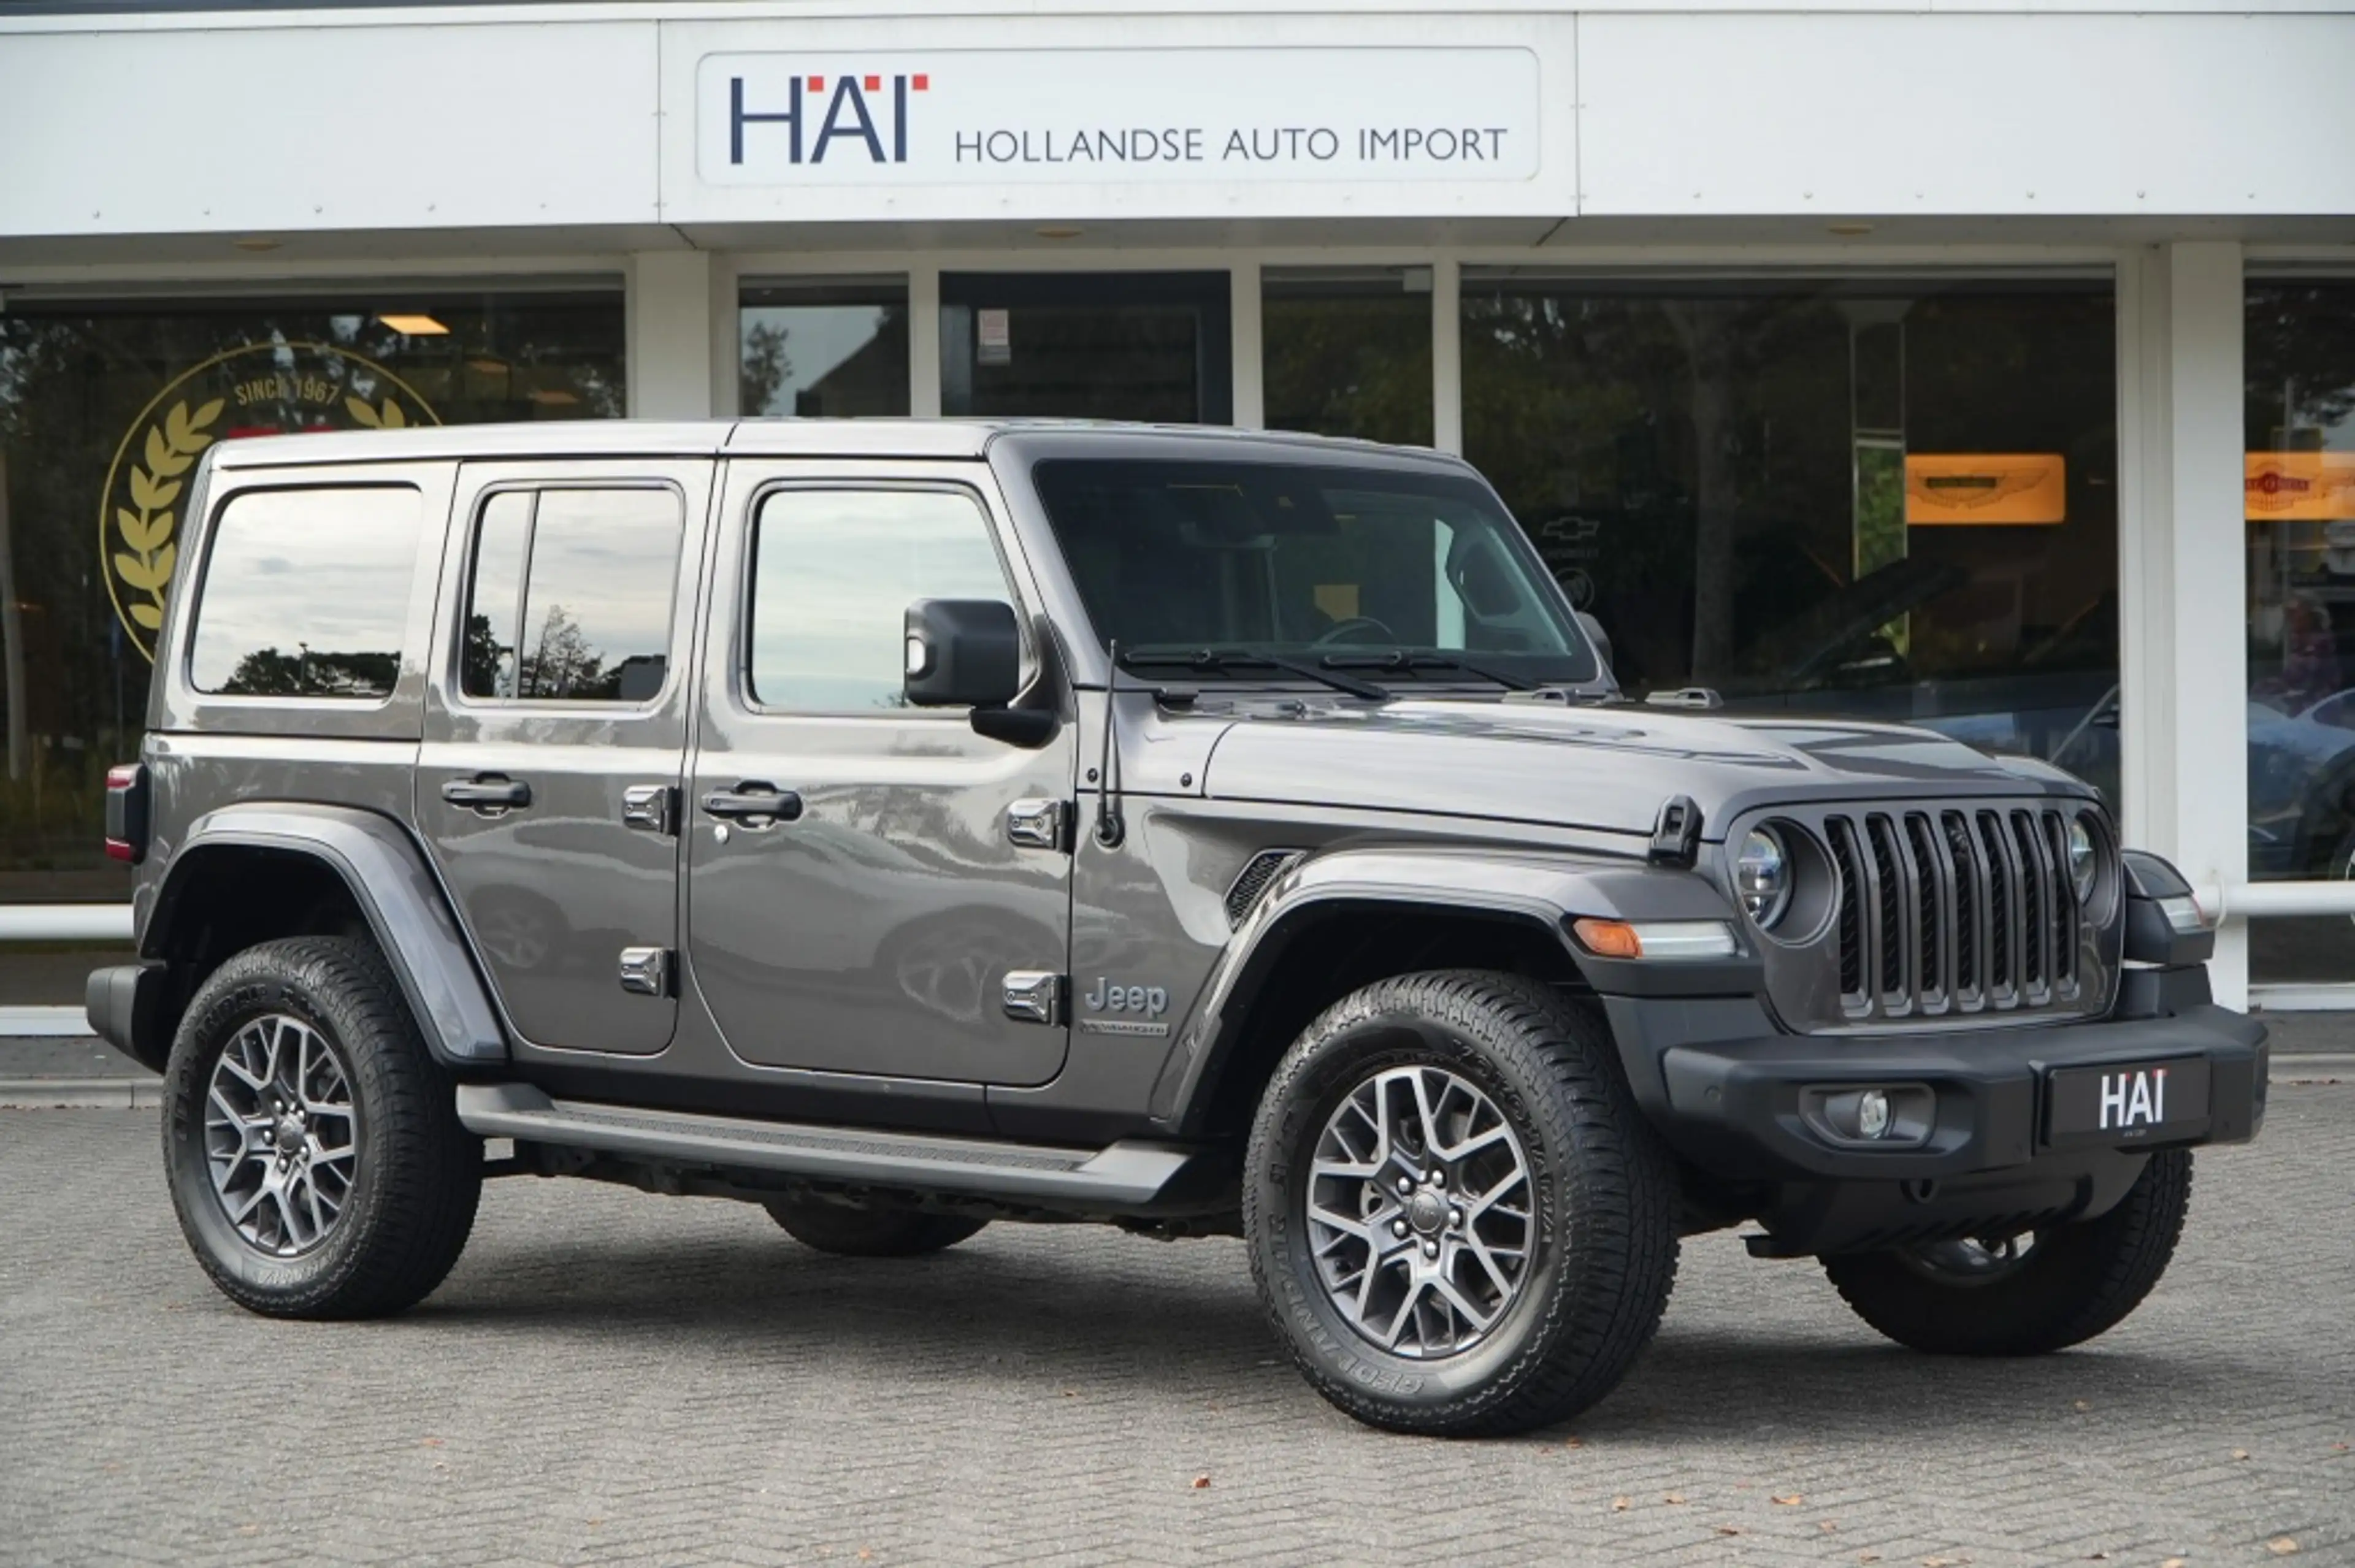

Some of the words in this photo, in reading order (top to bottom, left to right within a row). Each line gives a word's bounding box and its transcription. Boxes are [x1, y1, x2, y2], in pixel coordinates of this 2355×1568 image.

[730, 74, 929, 164] HAI
[955, 128, 1204, 163] HOLLANDSE
[1222, 128, 1339, 161] AUTO
[1359, 128, 1509, 161] IMPORT
[294, 375, 339, 405] 1967
[1085, 977, 1169, 1019] Jeep
[2099, 1068, 2169, 1130] HAI
